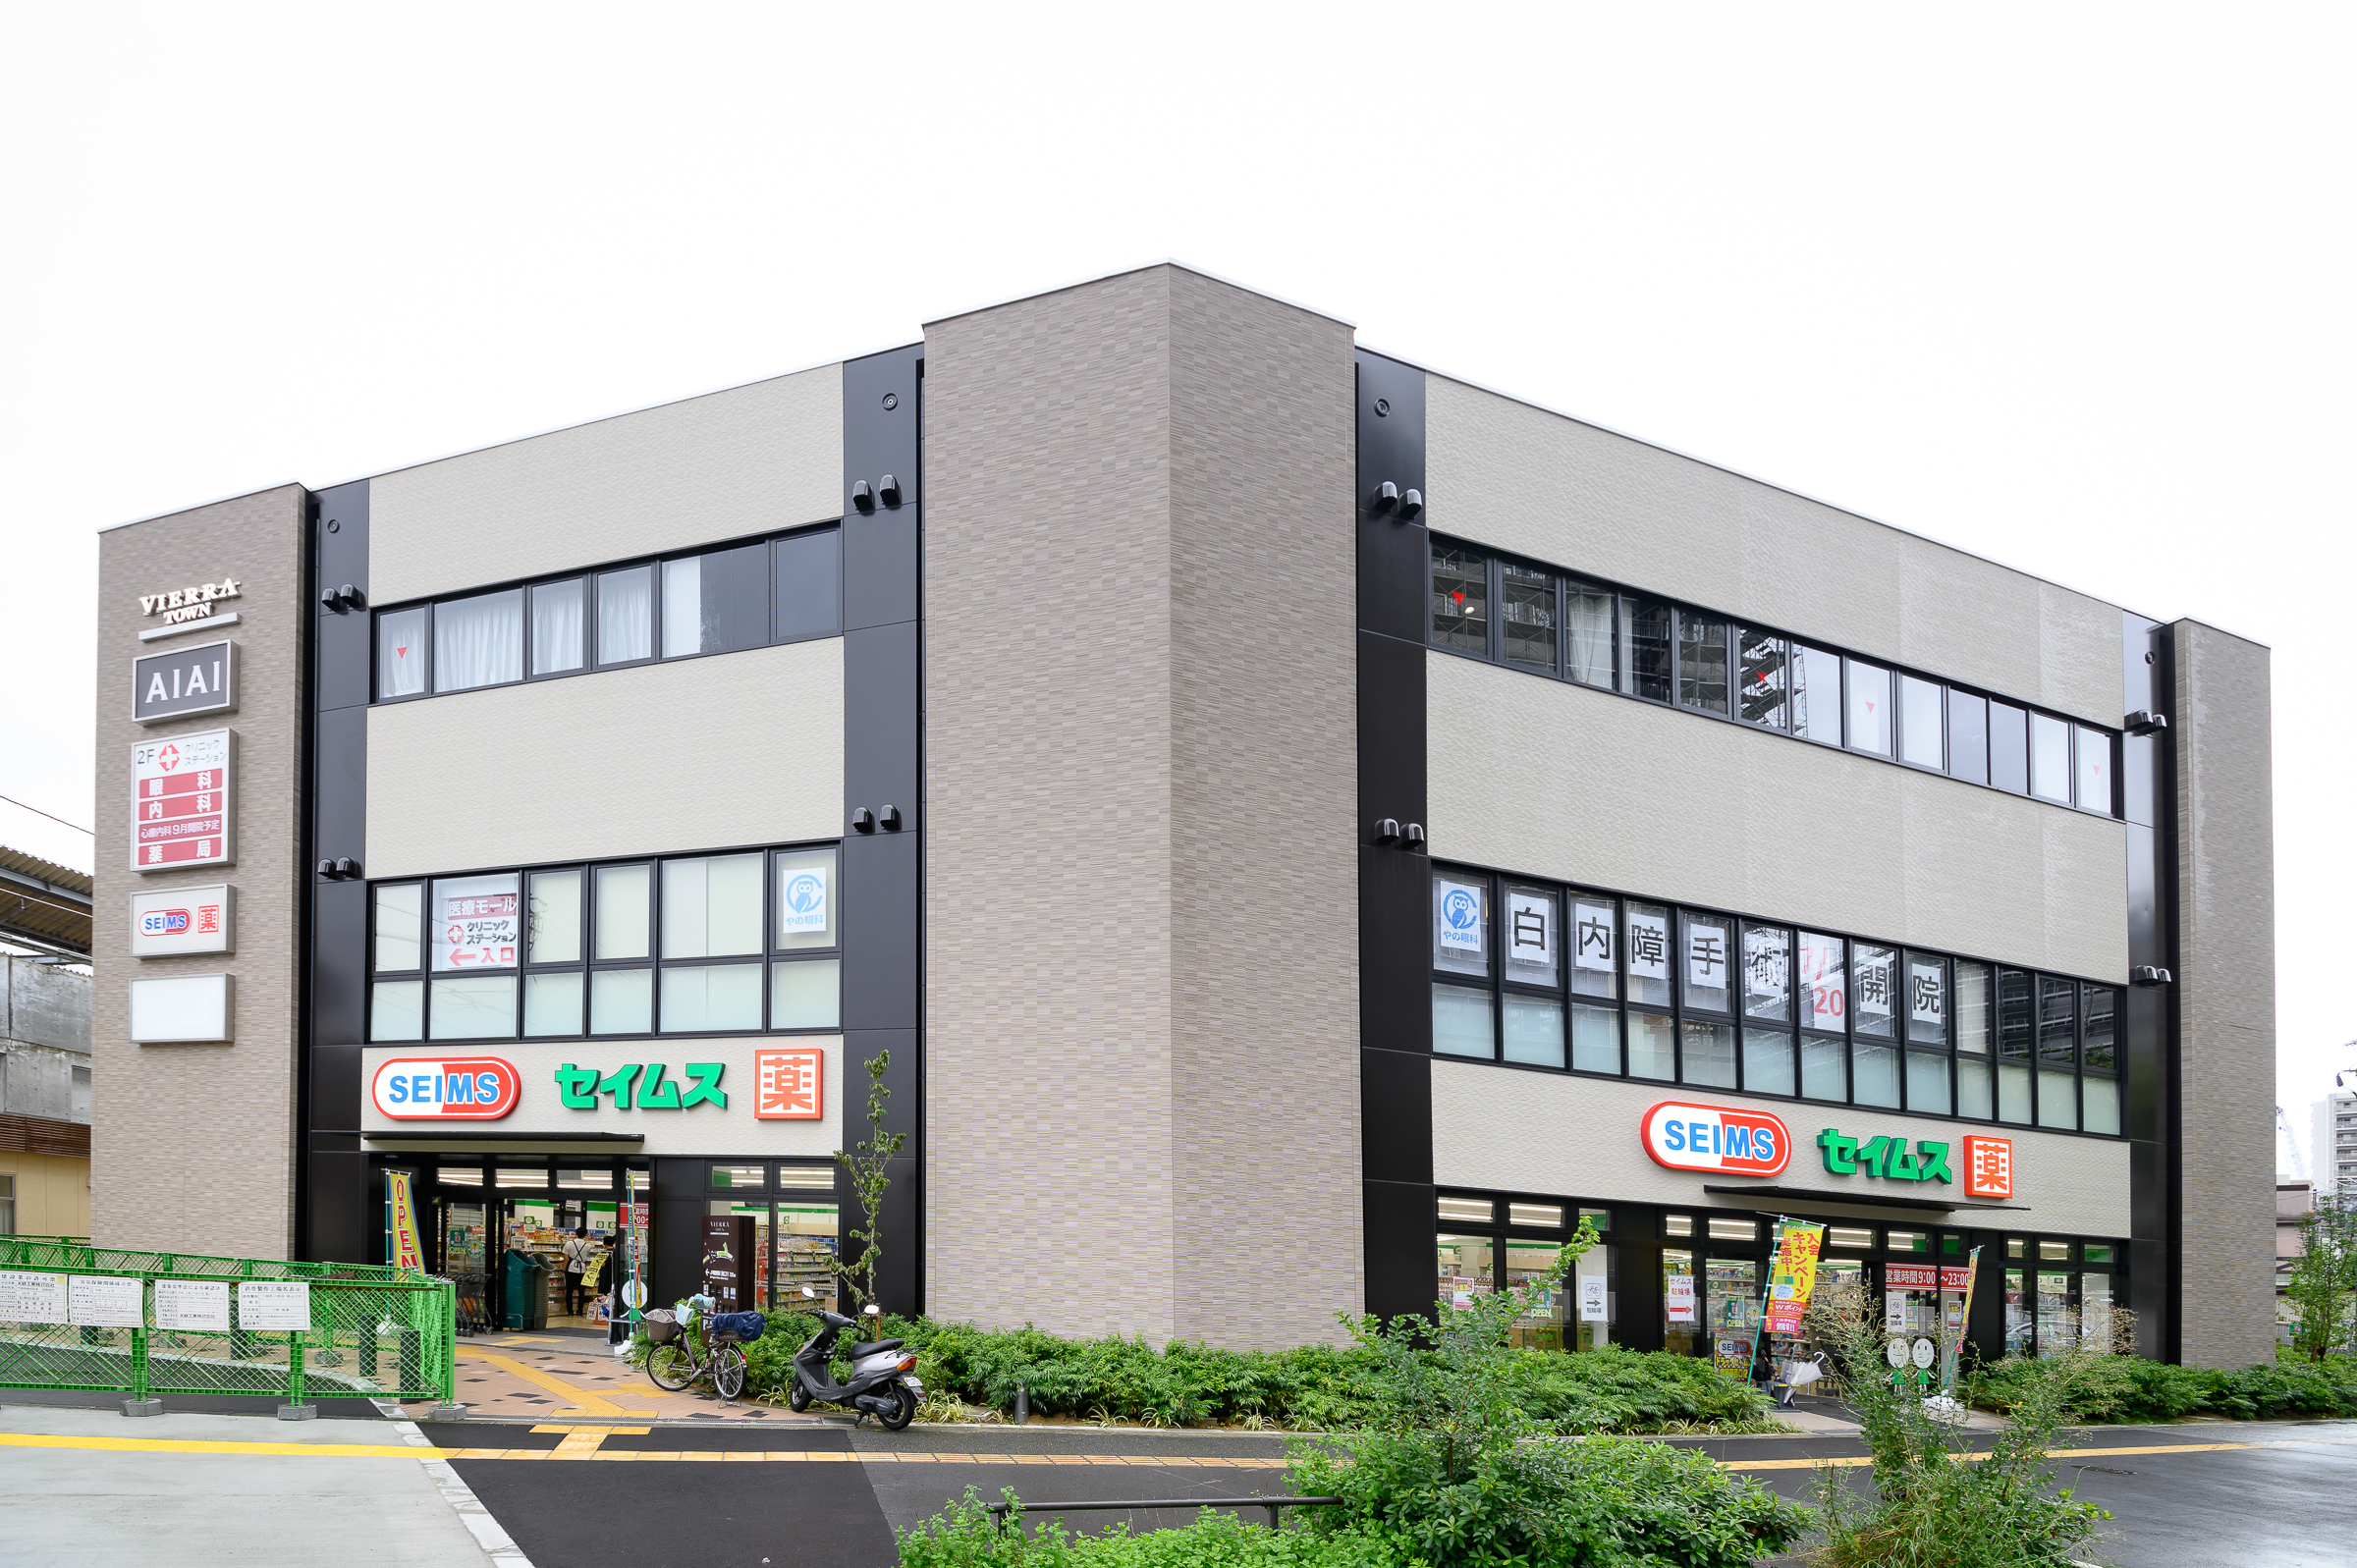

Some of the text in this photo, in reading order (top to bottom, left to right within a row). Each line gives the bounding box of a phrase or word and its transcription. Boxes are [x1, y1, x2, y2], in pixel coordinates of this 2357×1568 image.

[138, 577, 241, 616] VIERRA
[163, 602, 213, 624] TOWN
[145, 660, 221, 703] AIAI
[137, 748, 155, 765] 2F
[185, 739, 220, 753] クリニック
[185, 752, 227, 767] ステーション
[148, 793, 212, 819] 内科
[147, 839, 211, 864] 薬局
[448, 897, 517, 917] 医療モール
[145, 915, 187, 930] SEIMS
[200, 908, 217, 930] 薬
[466, 920, 510, 932] クリニック
[786, 914, 824, 926] やの眼科
[466, 932, 517, 945] ステーション
[1443, 929, 1479, 946] やの眼科
[480, 946, 515, 964] 入口
[388, 1073, 501, 1105] SEIMS
[554, 1062, 728, 1110] セイムス
[762, 1055, 814, 1111] 薬
[1664, 1119, 1776, 1162] SEIMS
[1817, 1128, 1952, 1184] セイムス
[1976, 1143, 2008, 1191] 薬
[396, 1178, 420, 1273] OPEN
[1807, 1232, 1820, 1256] 入会
[1793, 1232, 1809, 1299] キャンペーン
[1672, 1287, 1690, 1296] 駐輪場
